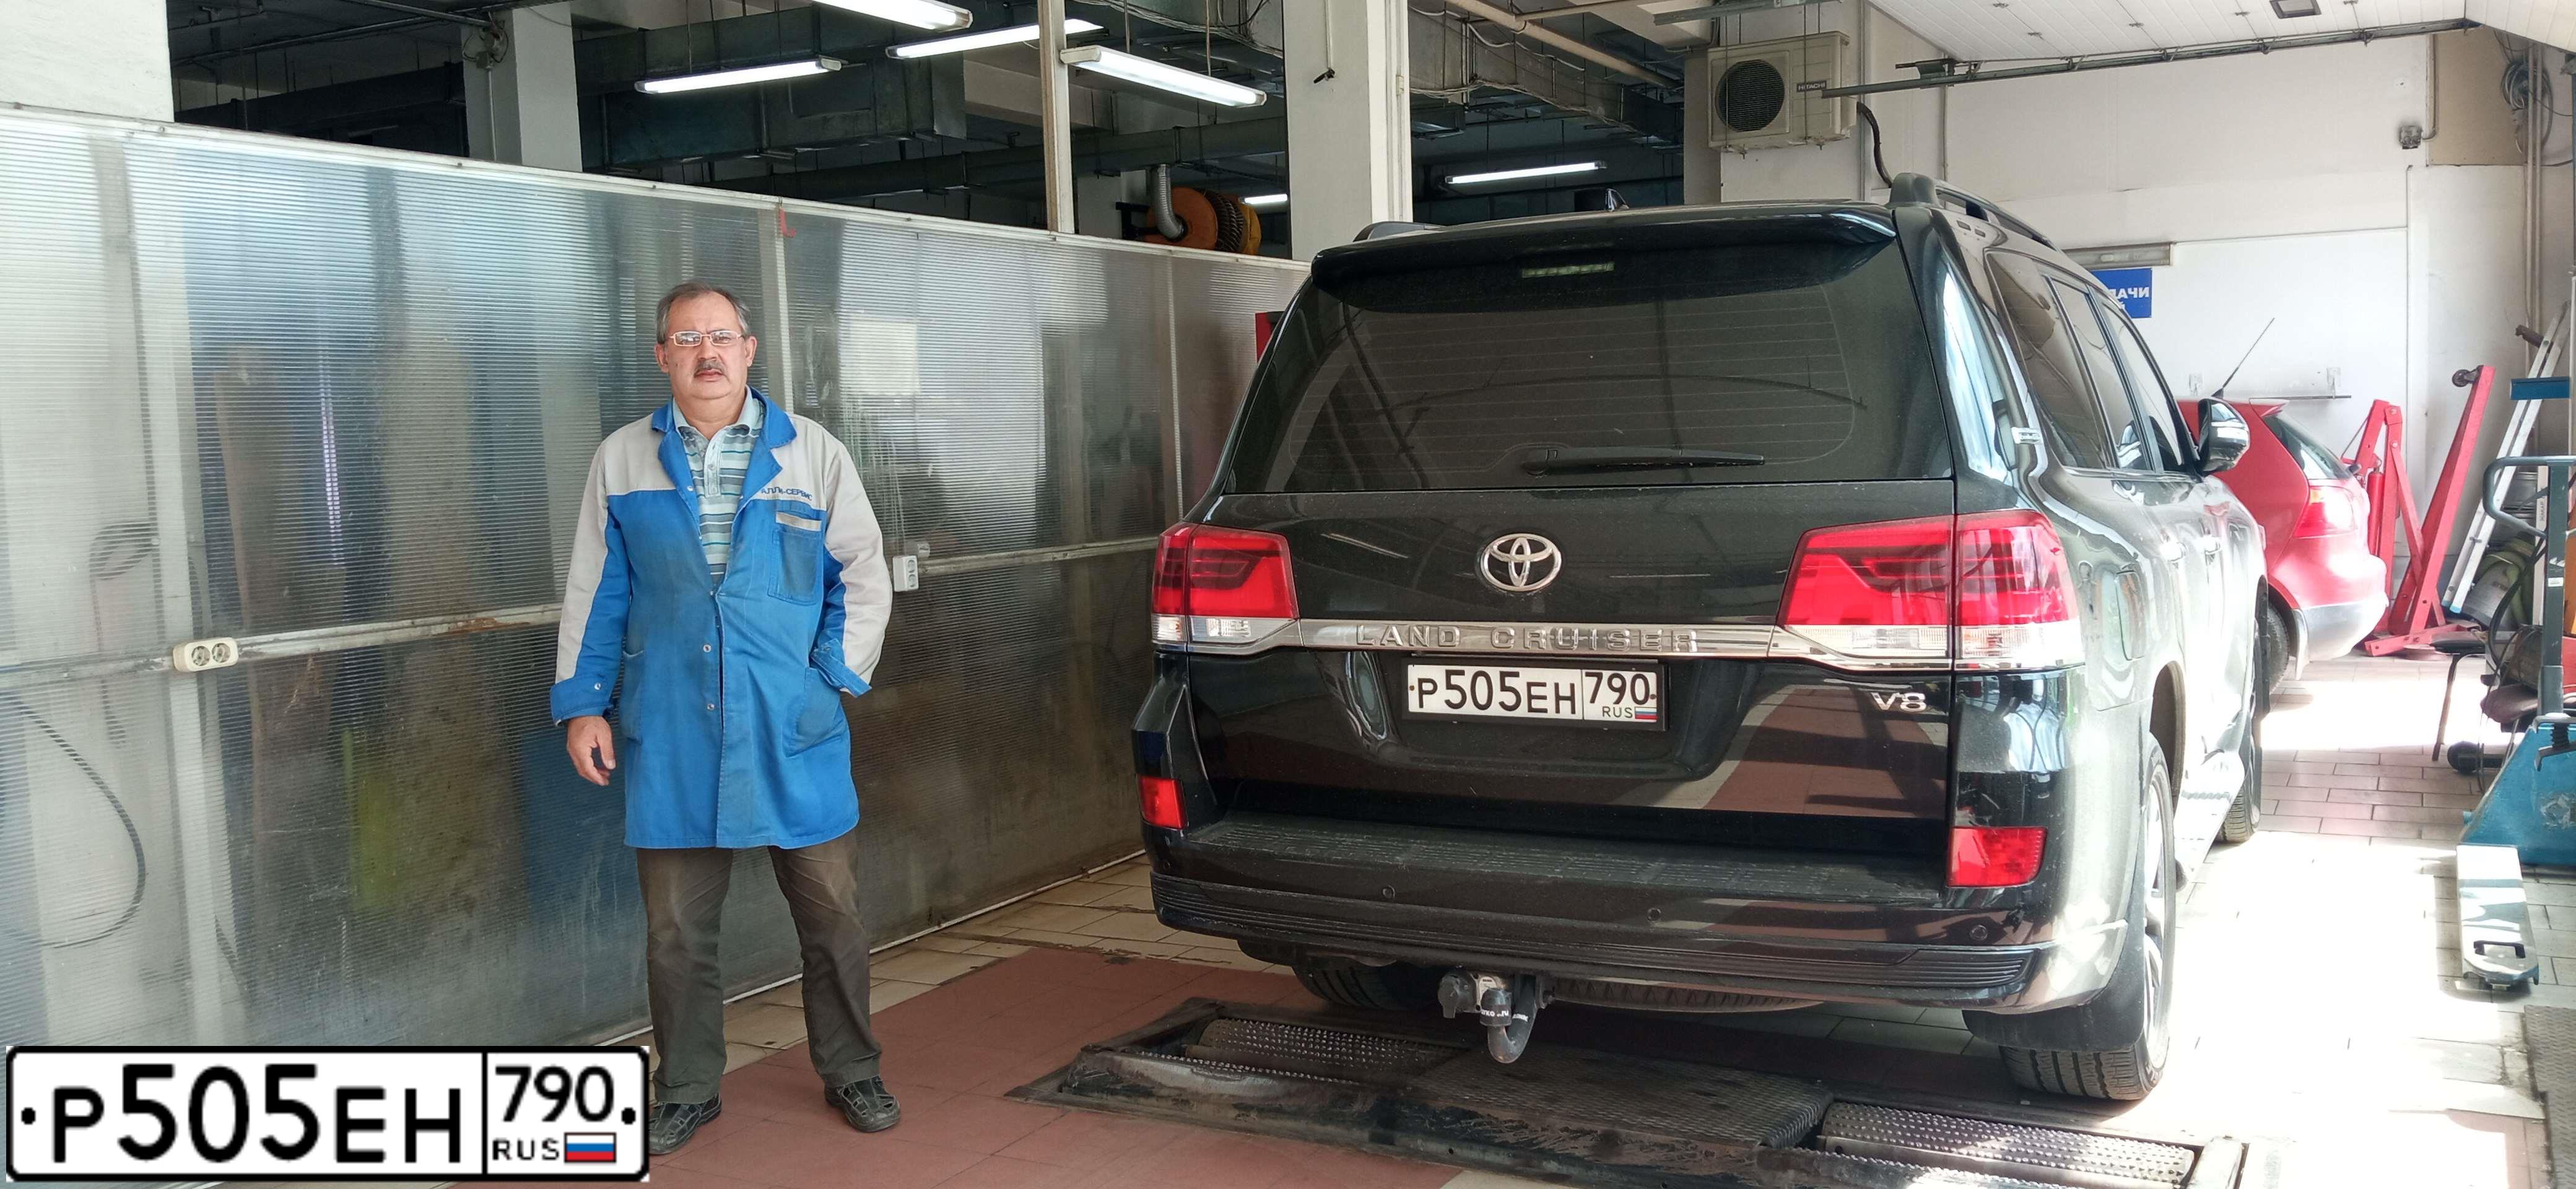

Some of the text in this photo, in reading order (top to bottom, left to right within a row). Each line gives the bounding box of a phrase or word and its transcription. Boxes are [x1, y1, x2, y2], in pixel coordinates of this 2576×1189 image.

[1798, 82, 1825, 90] HITACHI
[1355, 624, 1698, 654] LAND CRUISER
[1585, 672, 1651, 705] 790
[1601, 705, 1634, 719] RUS
[1871, 692, 1927, 713] V8
